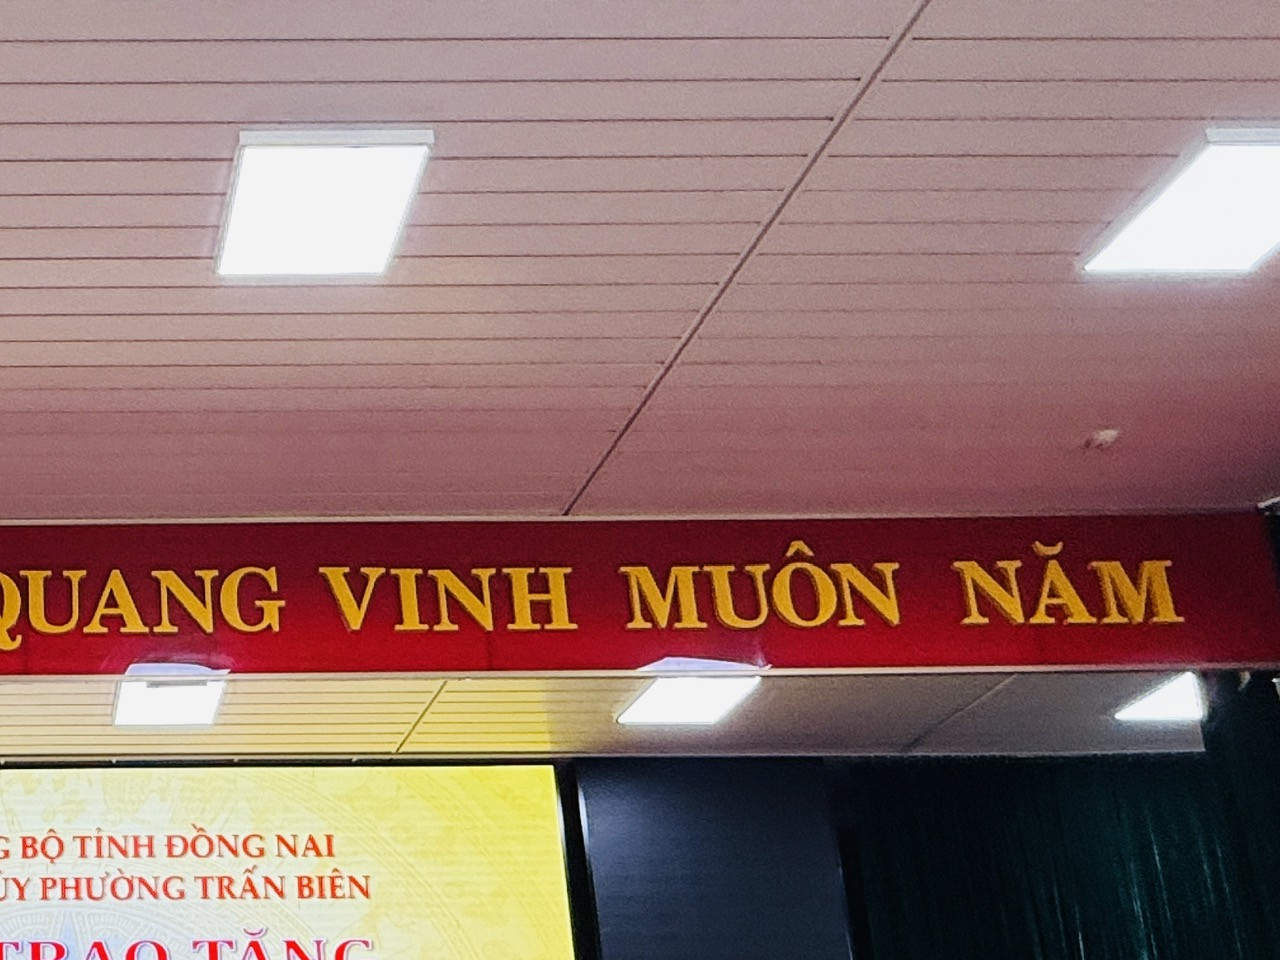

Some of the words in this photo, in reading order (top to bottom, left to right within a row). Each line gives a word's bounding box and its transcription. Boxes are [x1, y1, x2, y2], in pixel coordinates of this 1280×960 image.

[320, 567, 576, 631] VINH
[621, 541, 900, 628] MUÔN
[952, 541, 1185, 626] NĂM
[20, 828, 65, 865] BỘ
[74, 828, 155, 860] TỈNH
[165, 824, 266, 859] ĐỒNG
[276, 833, 336, 859] NAI
[39, 868, 186, 902] PHƯỜNG
[195, 865, 286, 901] TRẤN
[295, 868, 371, 901] BIÊN
